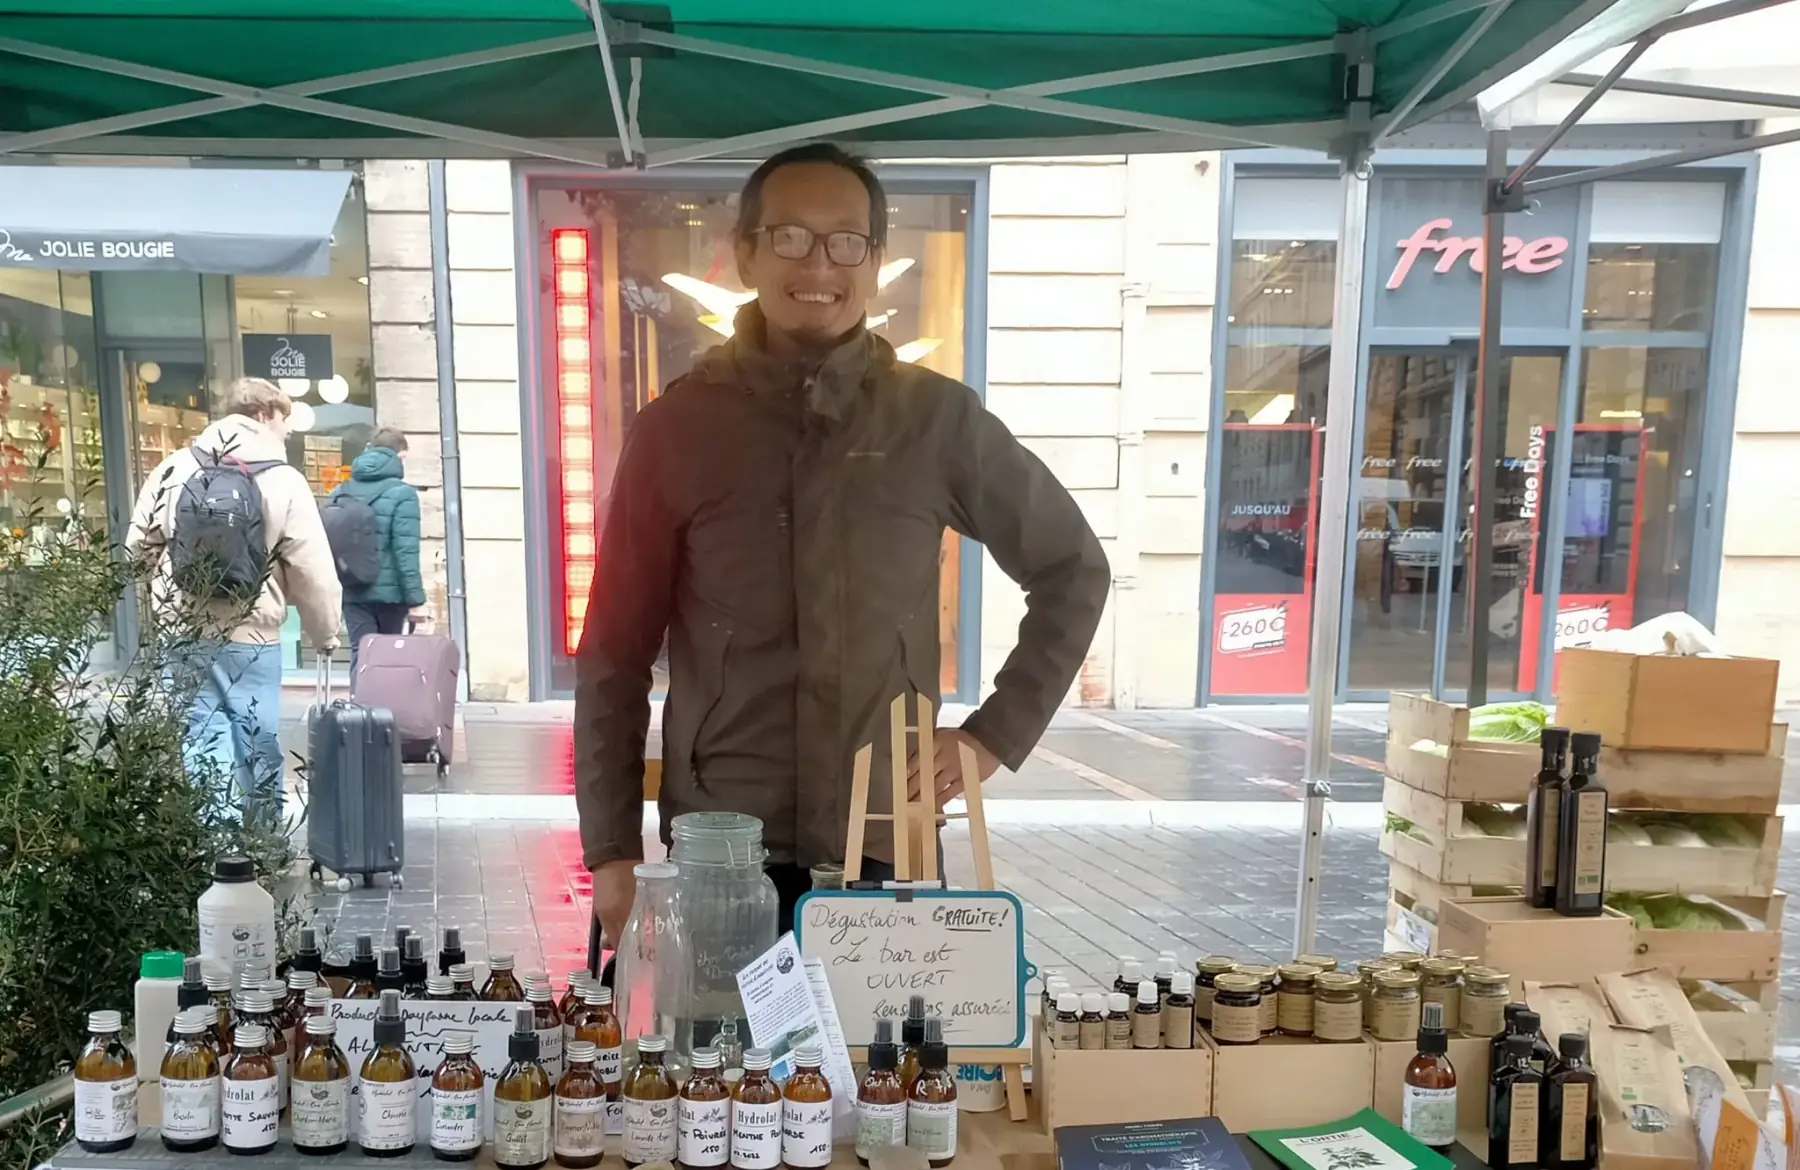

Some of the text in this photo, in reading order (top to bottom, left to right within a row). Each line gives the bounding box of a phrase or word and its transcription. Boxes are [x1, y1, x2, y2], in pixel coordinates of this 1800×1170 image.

[39, 241, 95, 258] JOLIE
[102, 242, 174, 258] BOUGIE
[1386, 218, 1568, 290] free
[271, 357, 306, 367] JOLIE
[271, 368, 306, 377] BOUGIE
[1524, 425, 1545, 473] Days
[1360, 456, 1443, 471] free free
[1520, 478, 1538, 518] Free
[1231, 505, 1291, 515] JUSQU'AU
[1400, 528, 1437, 541] free
[810, 904, 920, 945] Dégustatin
[880, 937, 915, 963] bar
[923, 943, 963, 962] est
[867, 969, 955, 990] OUVERT
[331, 1003, 380, 1020] Product
[738, 1109, 777, 1125] Hydrolat
[1300, 1133, 1348, 1143] L'ORTIE
